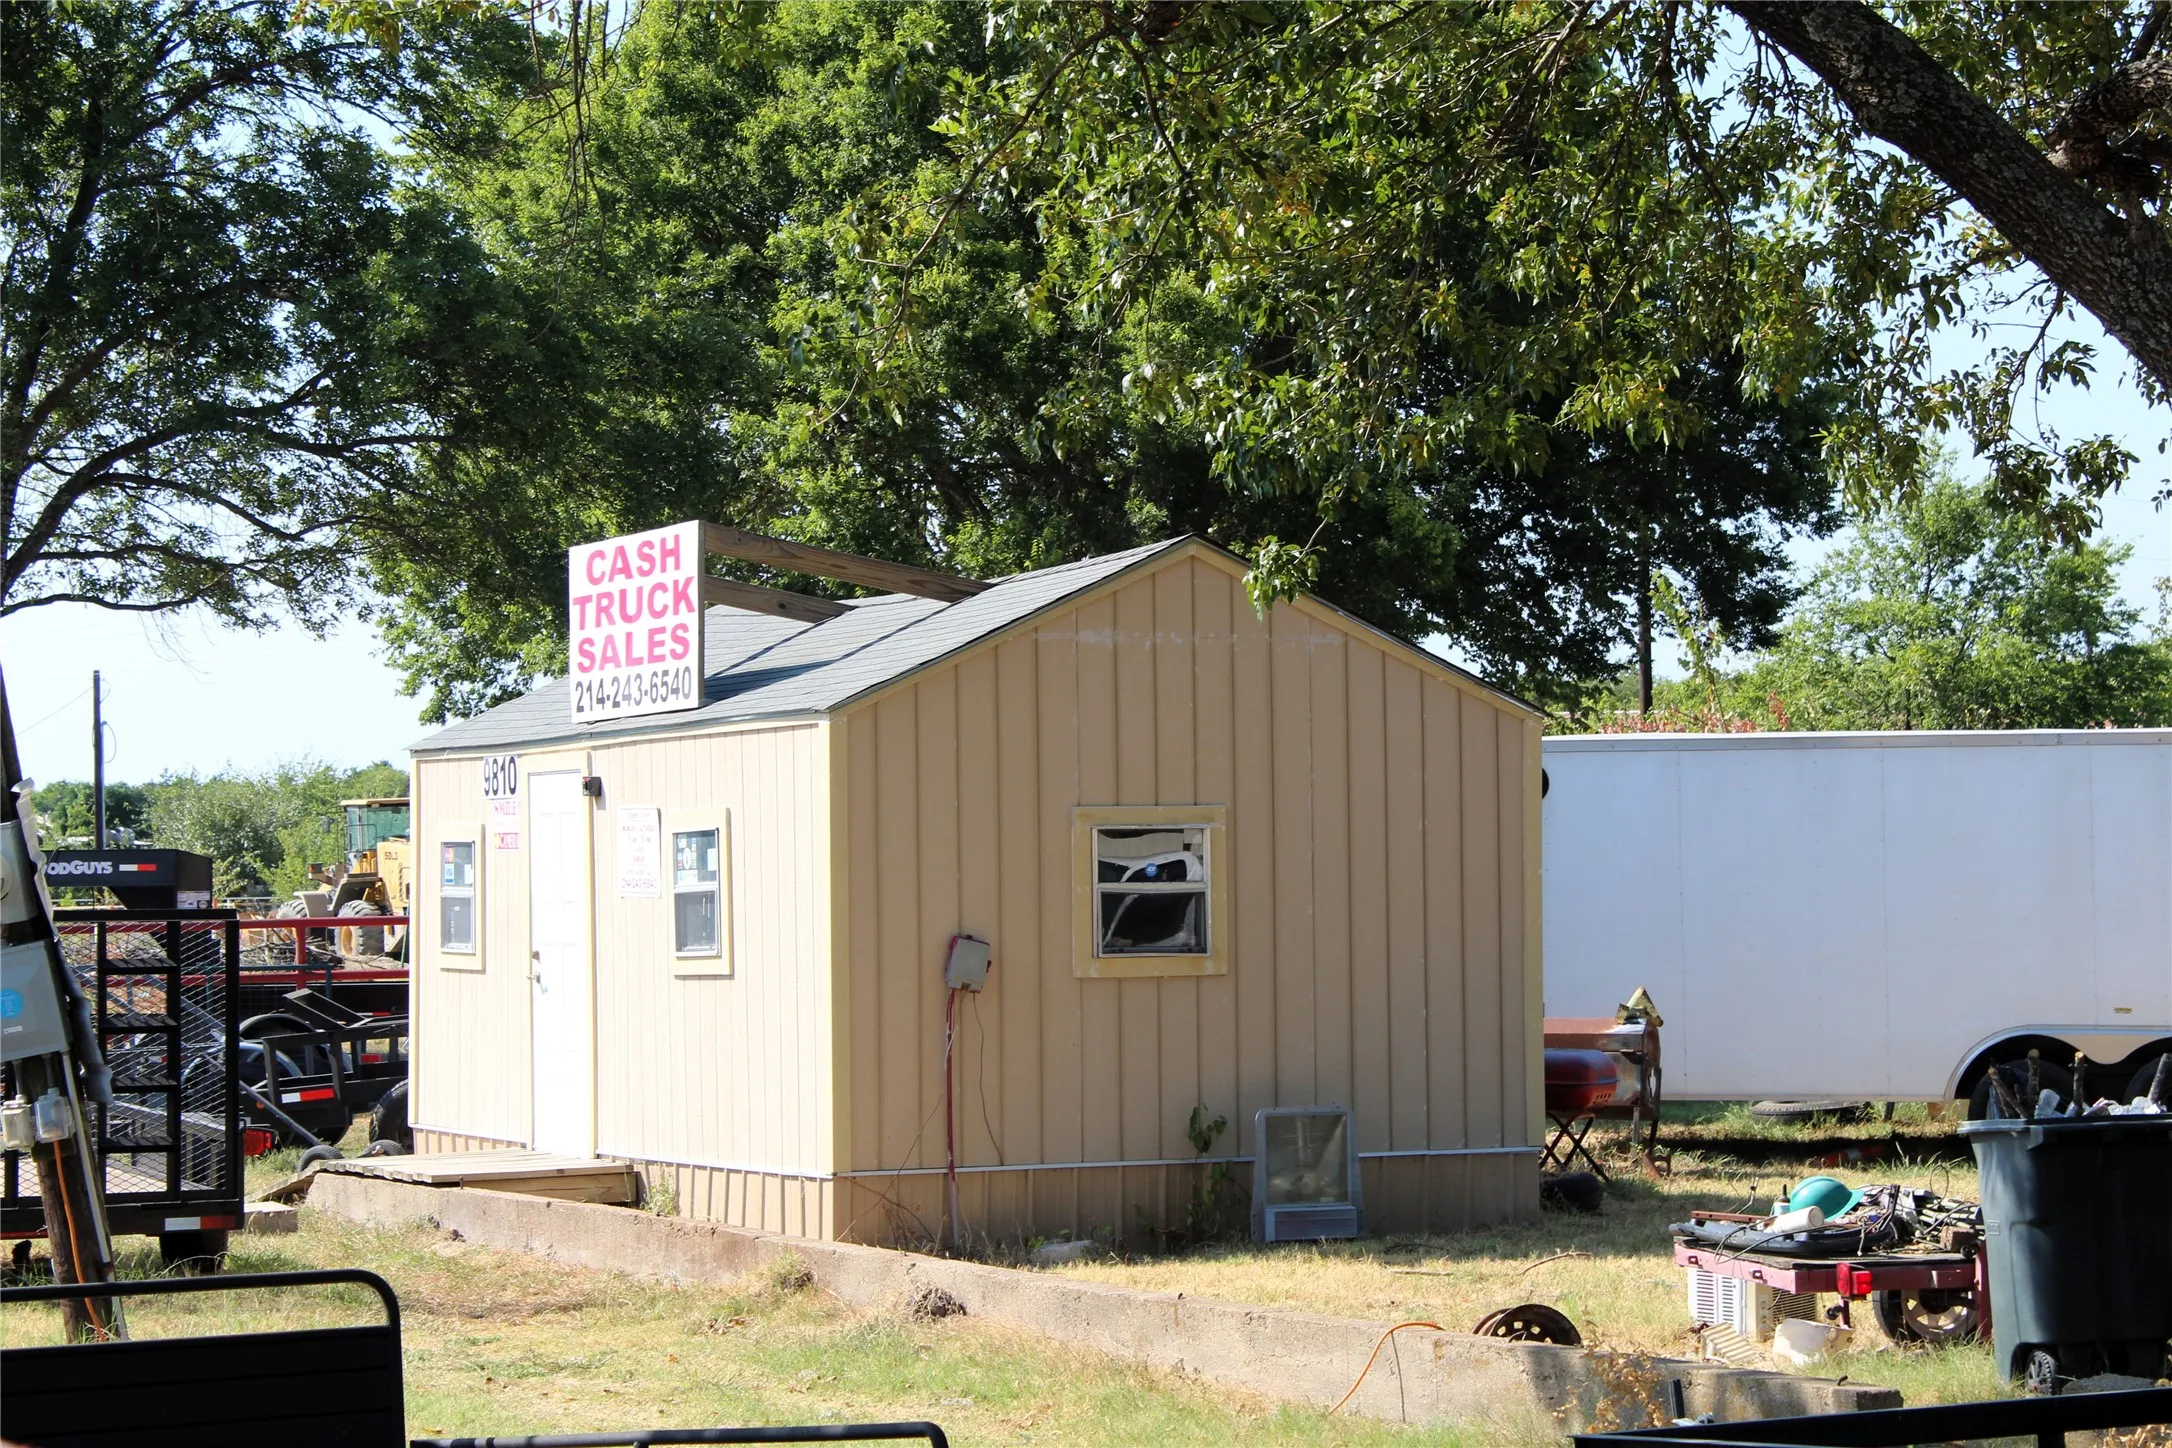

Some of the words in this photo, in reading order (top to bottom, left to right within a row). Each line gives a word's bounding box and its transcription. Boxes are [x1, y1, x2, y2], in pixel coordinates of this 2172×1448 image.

[587, 534, 680, 585] CASH
[573, 576, 696, 630] TRUCK
[577, 623, 690, 673] SALES
[575, 666, 692, 713] 214-243-6540
[483, 755, 517, 796] 9810
